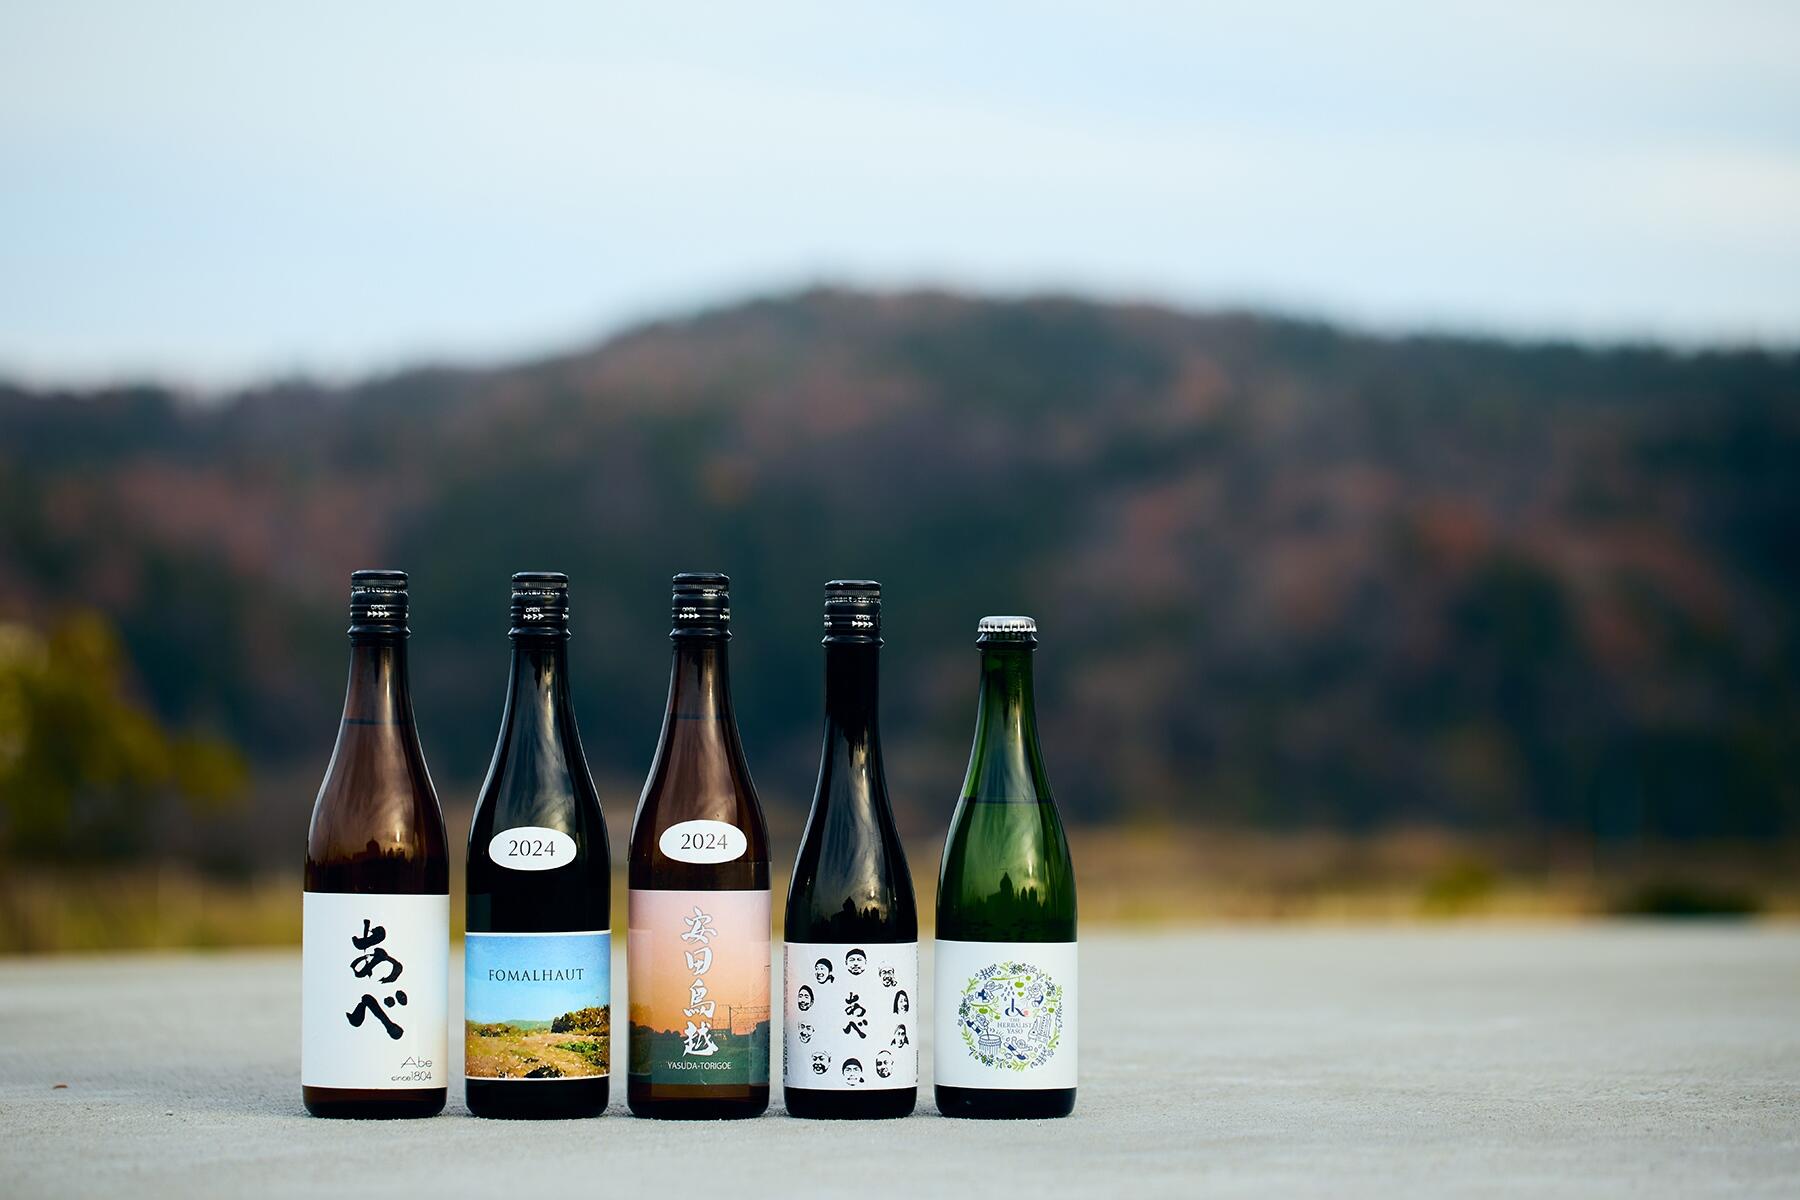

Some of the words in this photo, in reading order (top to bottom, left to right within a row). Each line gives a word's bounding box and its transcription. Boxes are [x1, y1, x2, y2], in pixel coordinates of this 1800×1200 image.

[508, 840, 555, 856] 2024
[681, 833, 728, 850] 2024
[346, 919, 407, 1040] あべ
[489, 969, 584, 981] FOMALHAUT
[843, 992, 868, 1039] あべ
[401, 1056, 432, 1068] Abe
